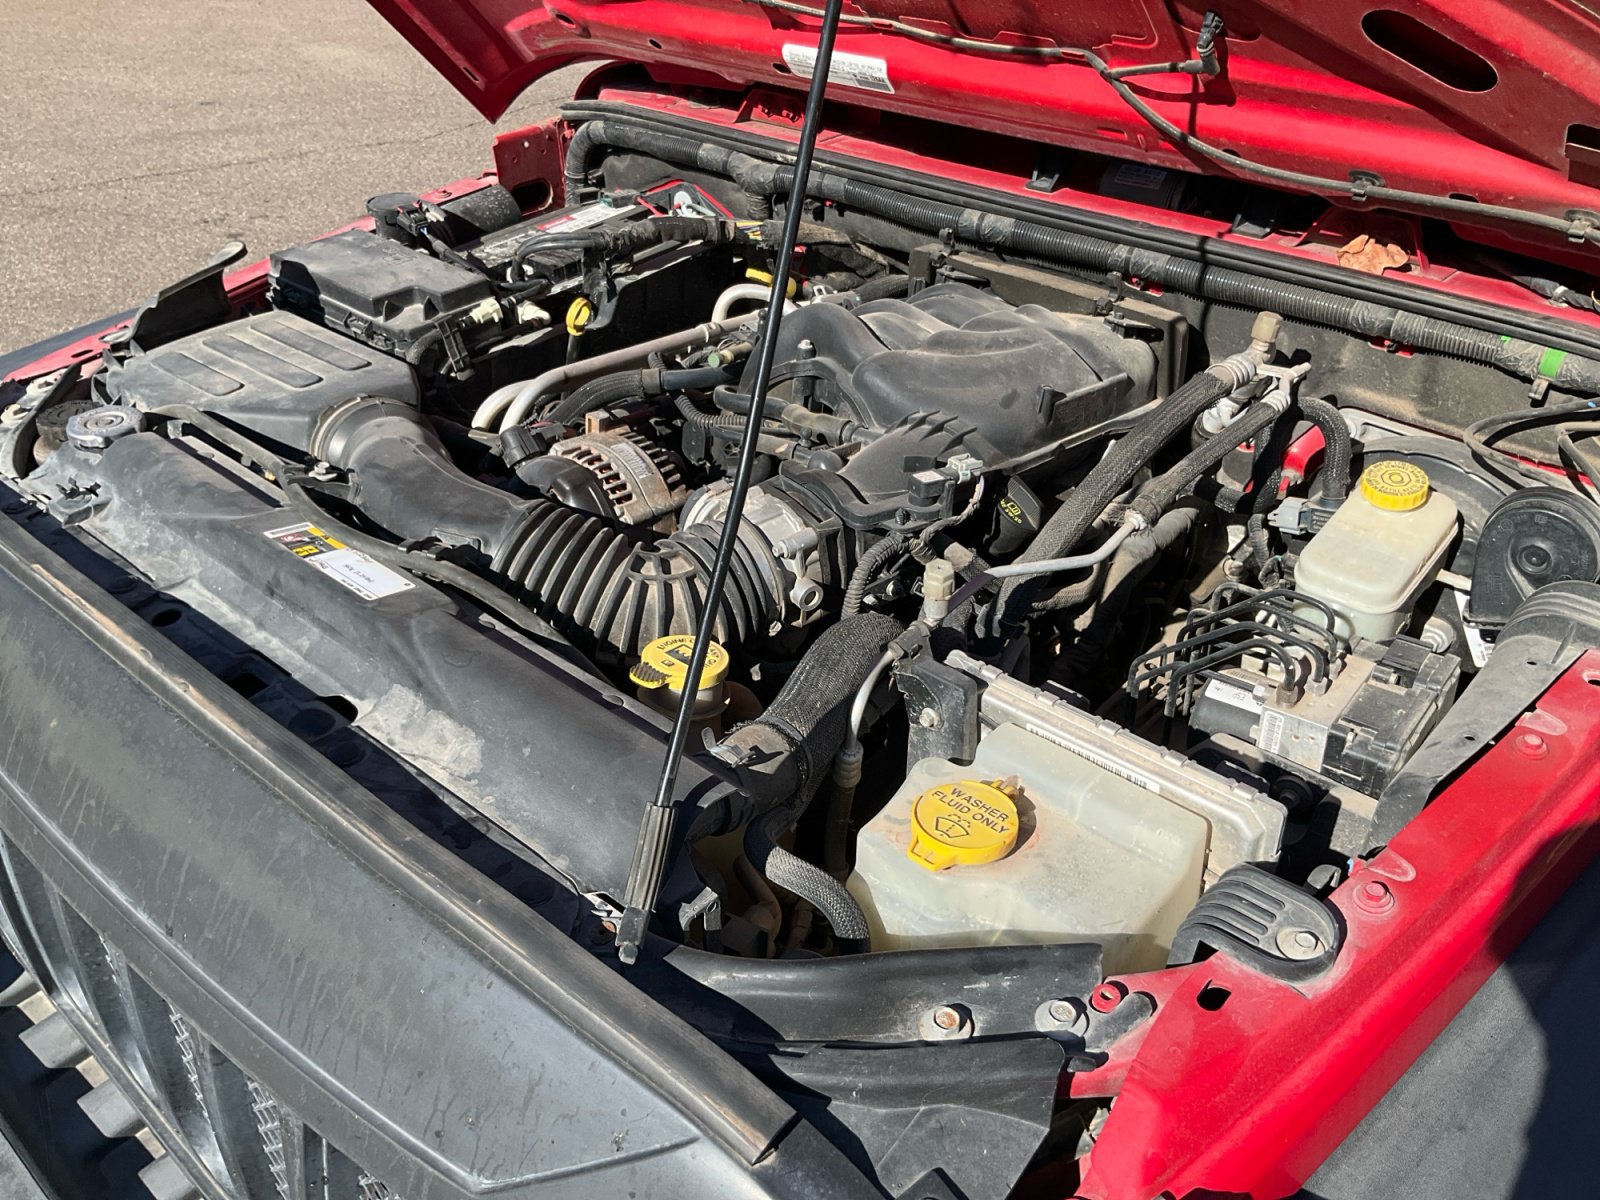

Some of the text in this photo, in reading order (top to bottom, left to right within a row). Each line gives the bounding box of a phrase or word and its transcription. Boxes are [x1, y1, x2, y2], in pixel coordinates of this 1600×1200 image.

[931, 790, 1010, 834] FLUID ONLY
[951, 787, 1010, 822] WASHER
